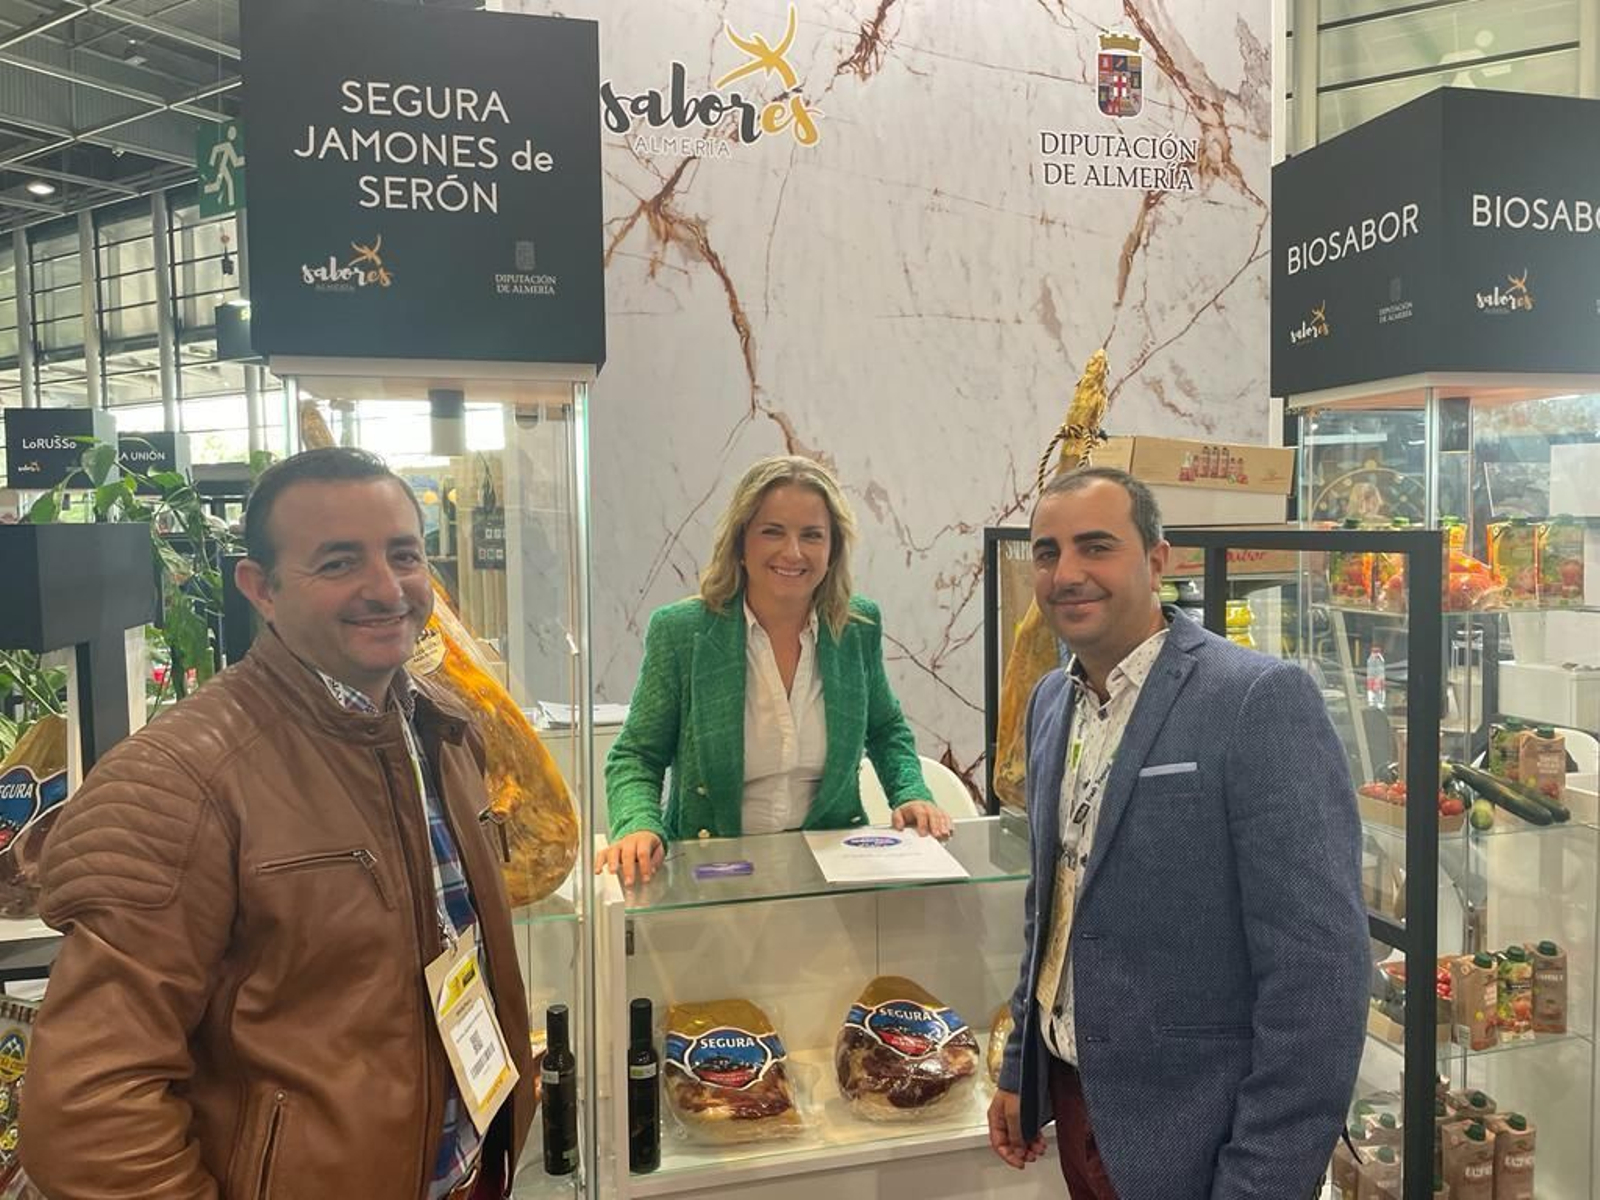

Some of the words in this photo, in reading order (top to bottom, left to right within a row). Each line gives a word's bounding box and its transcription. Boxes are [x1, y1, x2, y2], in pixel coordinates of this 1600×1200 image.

[341, 79, 510, 124] SEGURA
[600, 61, 824, 146] sabores
[293, 125, 499, 170] JAMONES
[511, 139, 554, 173] de
[634, 134, 732, 157] ALMERÍA
[1040, 131, 1198, 162] DIPUTACIÓN
[359, 173, 498, 214] SERÓN
[1043, 162, 1076, 186] DE
[1083, 162, 1194, 191] ALMERÍA
[1472, 193, 1600, 233] BIOSAB
[1287, 203, 1420, 276] BIOSABOR
[302, 255, 393, 288] sabores
[880, 1007, 932, 1022] SEGURA
[700, 1037, 756, 1050] SEGURA
